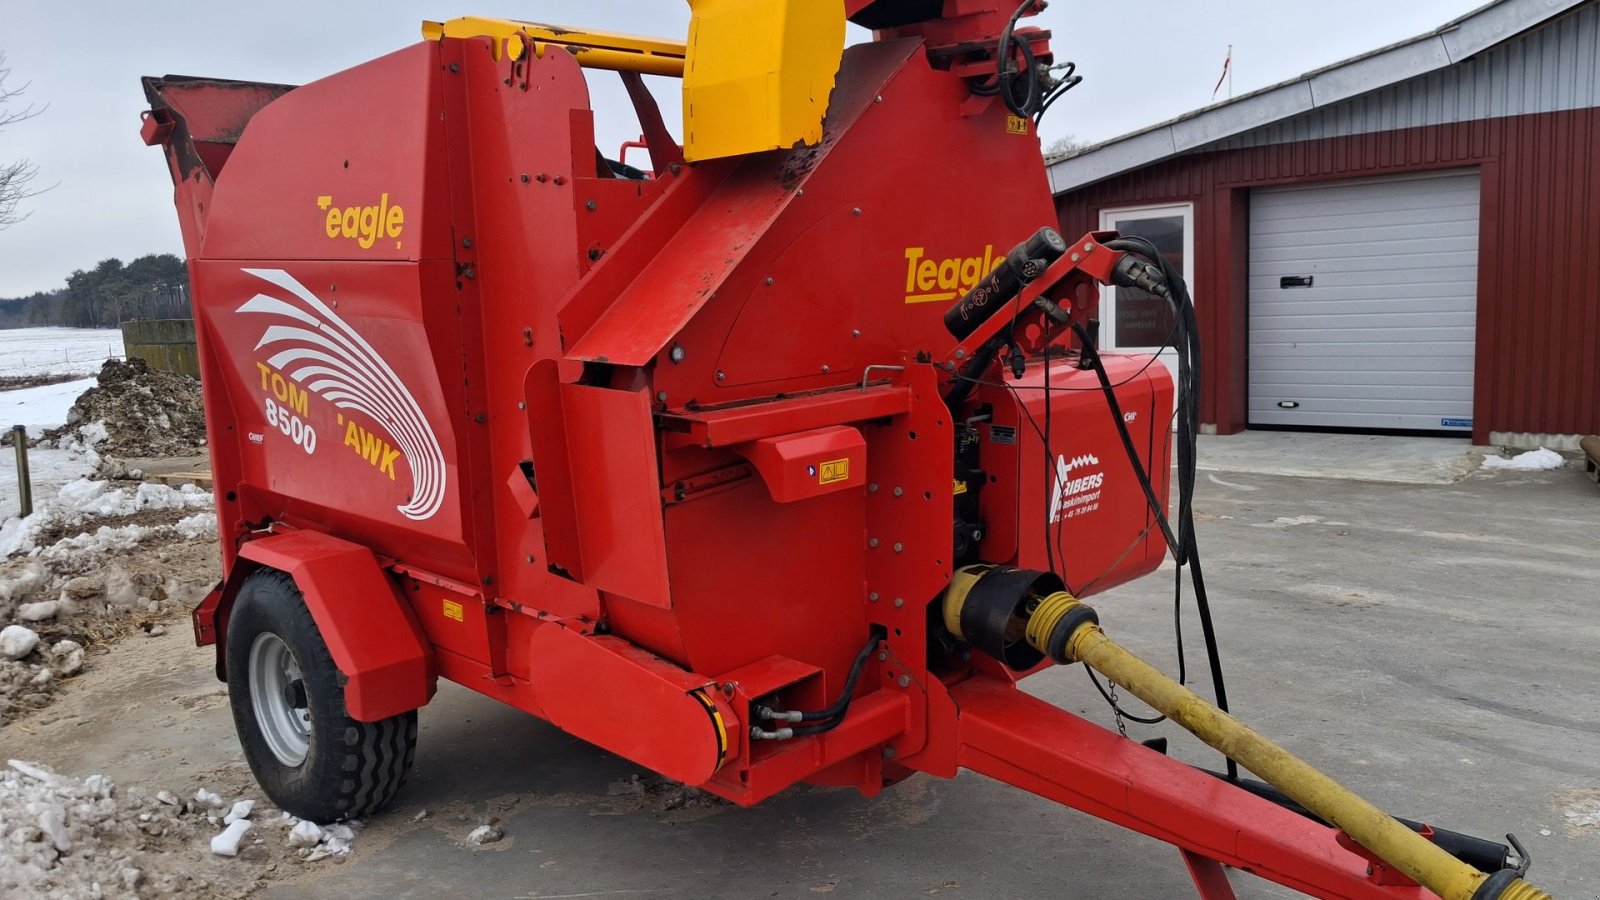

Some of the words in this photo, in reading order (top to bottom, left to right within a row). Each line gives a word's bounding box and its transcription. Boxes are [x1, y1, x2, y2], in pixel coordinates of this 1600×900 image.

[256, 361, 309, 417] TOM
[337, 413, 401, 480] AWK
[265, 397, 317, 456] 8500
